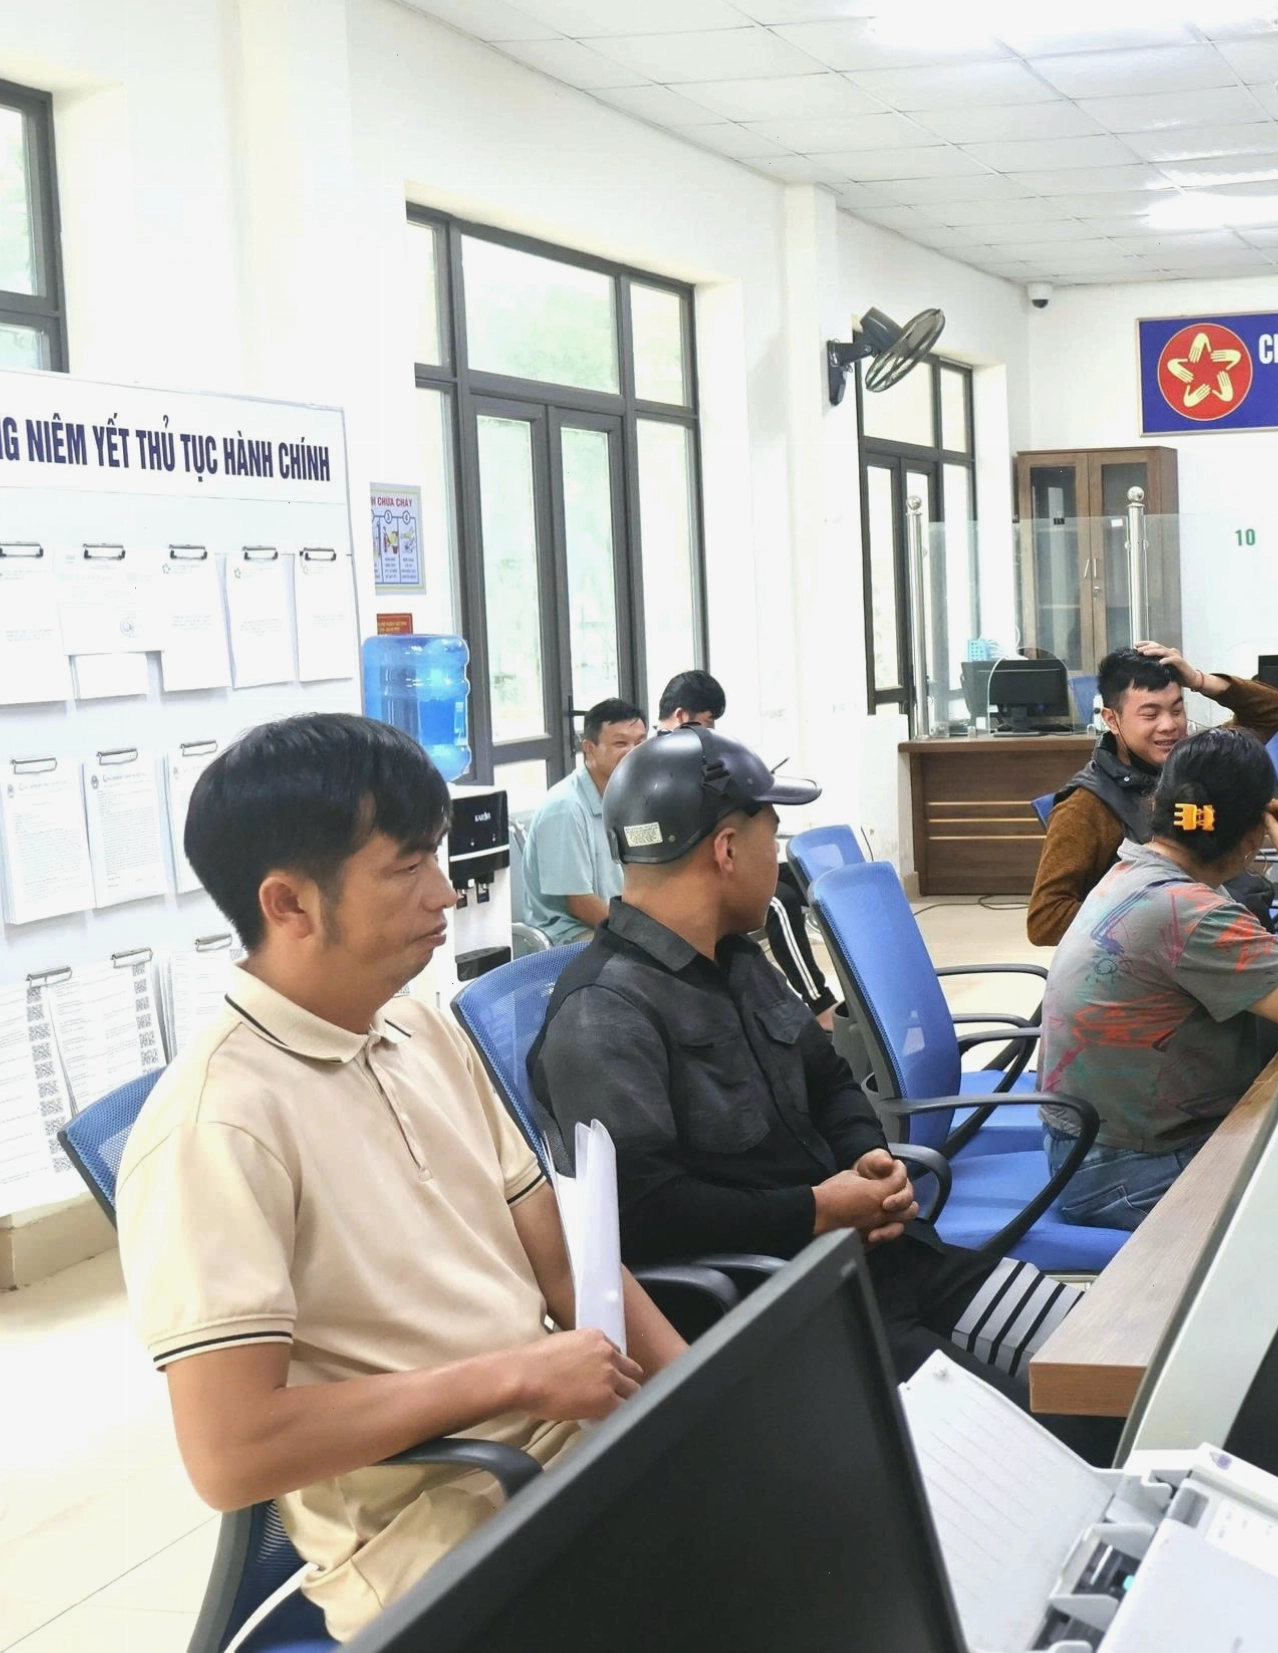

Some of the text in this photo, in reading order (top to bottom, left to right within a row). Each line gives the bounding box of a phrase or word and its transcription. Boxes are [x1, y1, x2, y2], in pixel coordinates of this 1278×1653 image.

[26, 412, 88, 466] NIÊM
[92, 412, 130, 469] YẾT
[135, 414, 176, 472] THỦ
[180, 433, 218, 483] TỤC
[223, 430, 274, 478] HÀNH
[278, 436, 331, 482] CHÍNH
[1235, 528, 1256, 547] 10
